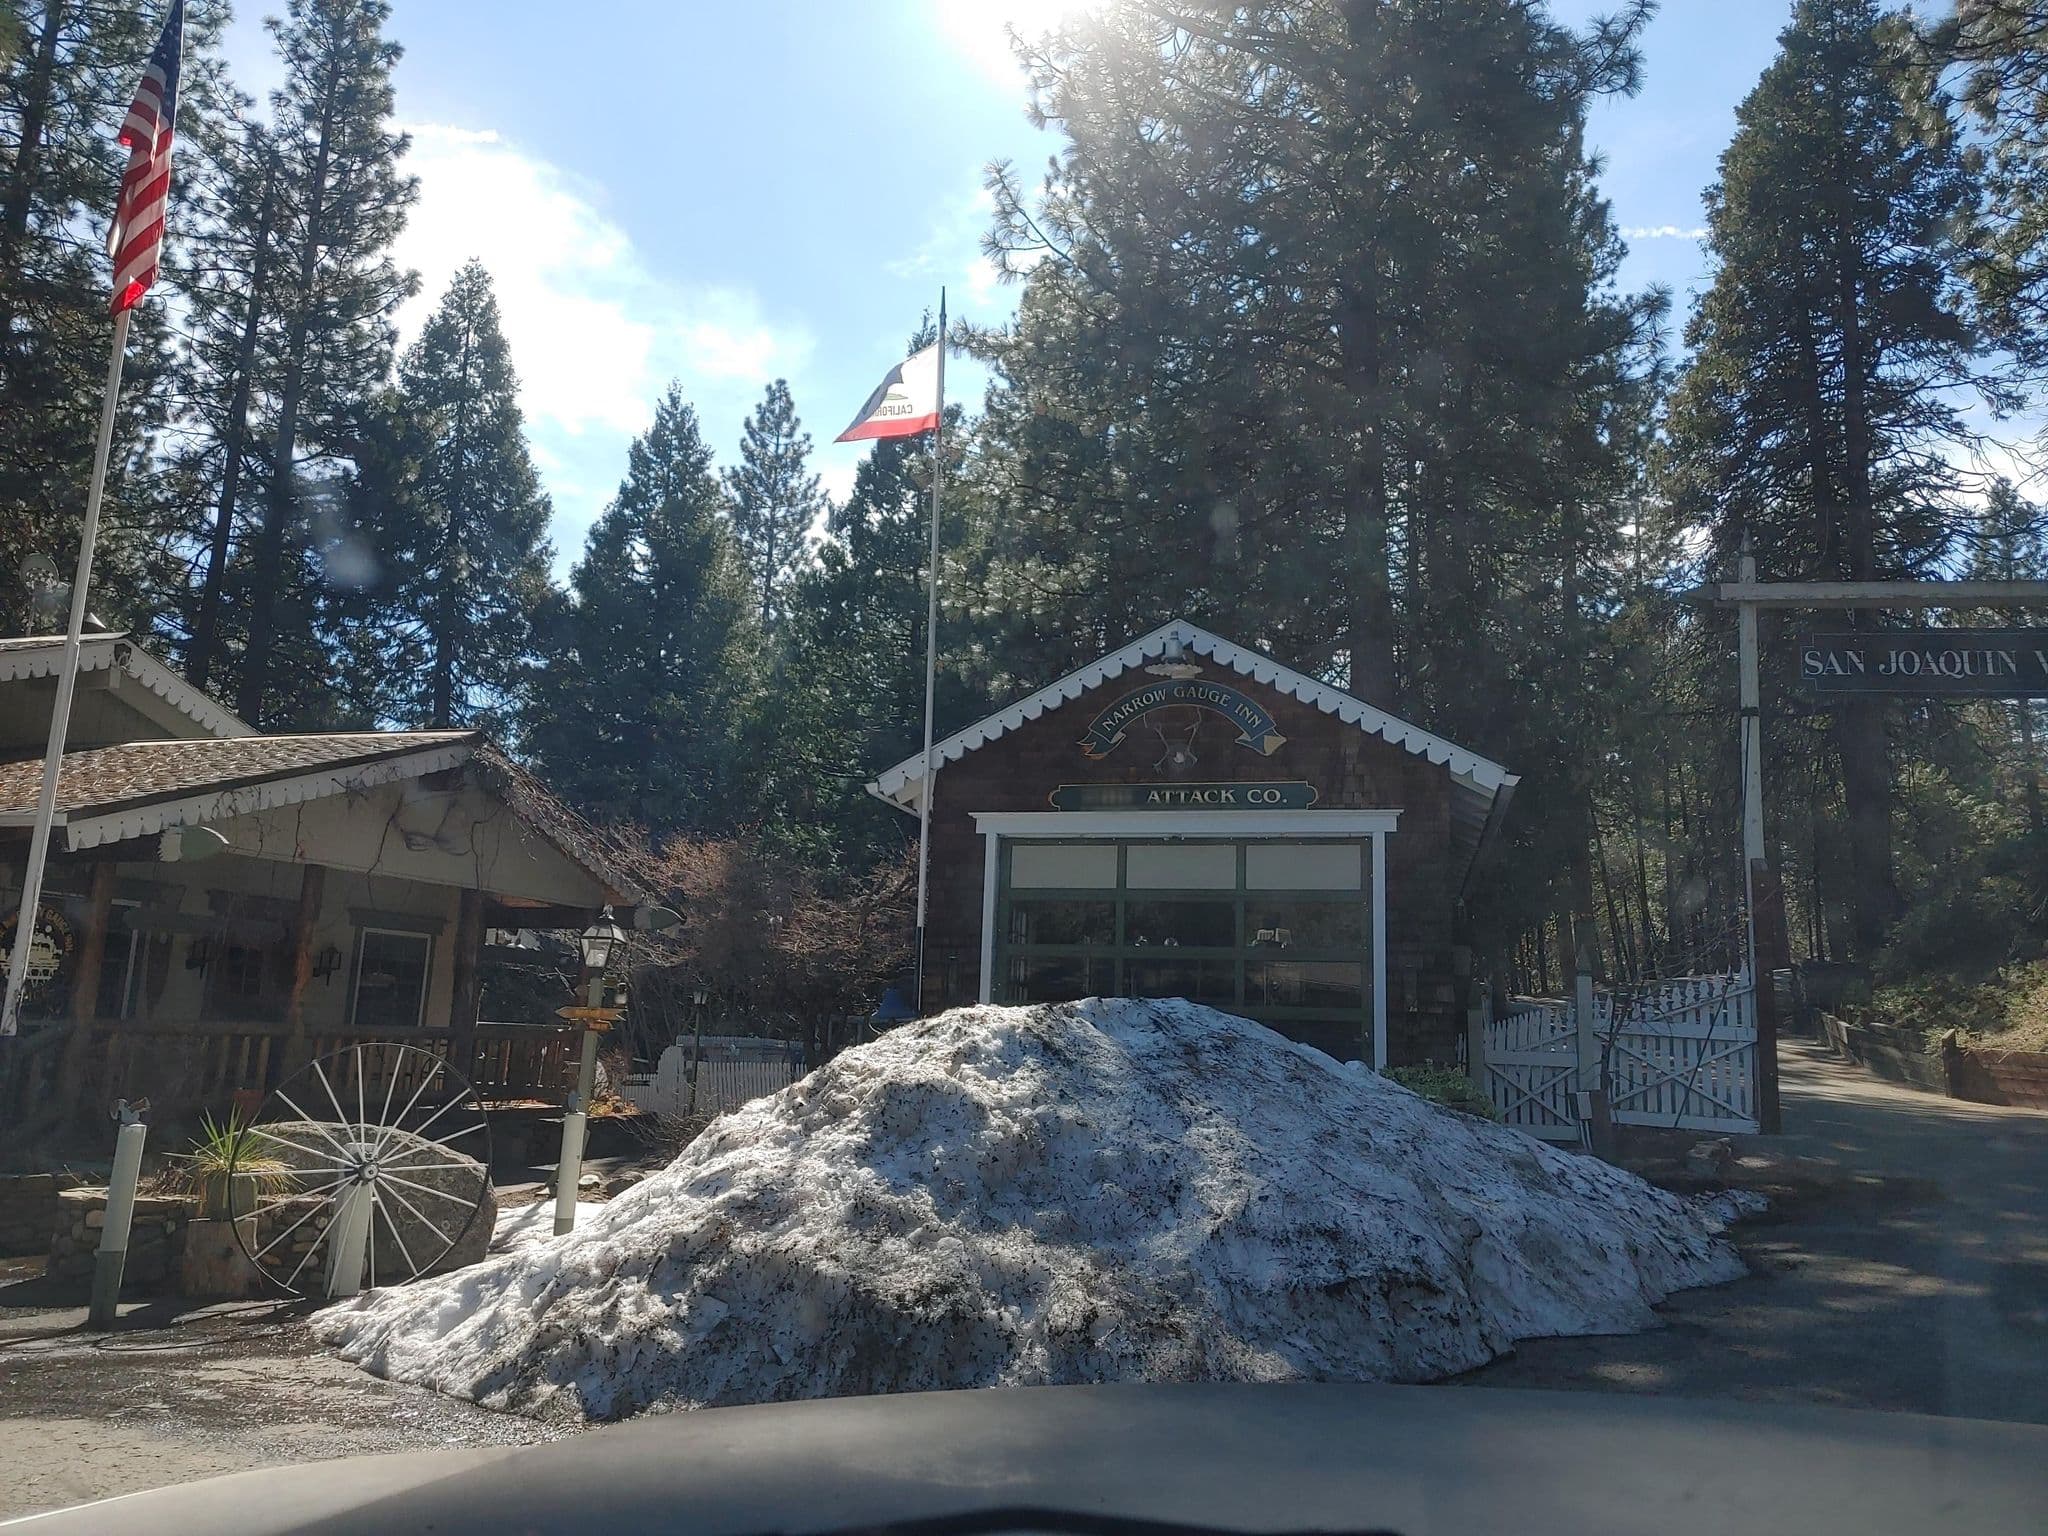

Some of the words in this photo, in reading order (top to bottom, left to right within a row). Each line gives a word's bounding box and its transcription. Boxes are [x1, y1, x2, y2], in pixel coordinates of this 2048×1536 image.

[1804, 650, 1865, 675] SAN
[1879, 650, 2017, 679] JOAQUIN
[1102, 688, 1168, 732] NARROW
[1174, 686, 1232, 707] GAUGE
[1235, 703, 1263, 728] INN
[1147, 789, 1236, 804] ATTACK
[1247, 788, 1288, 804] CO.
